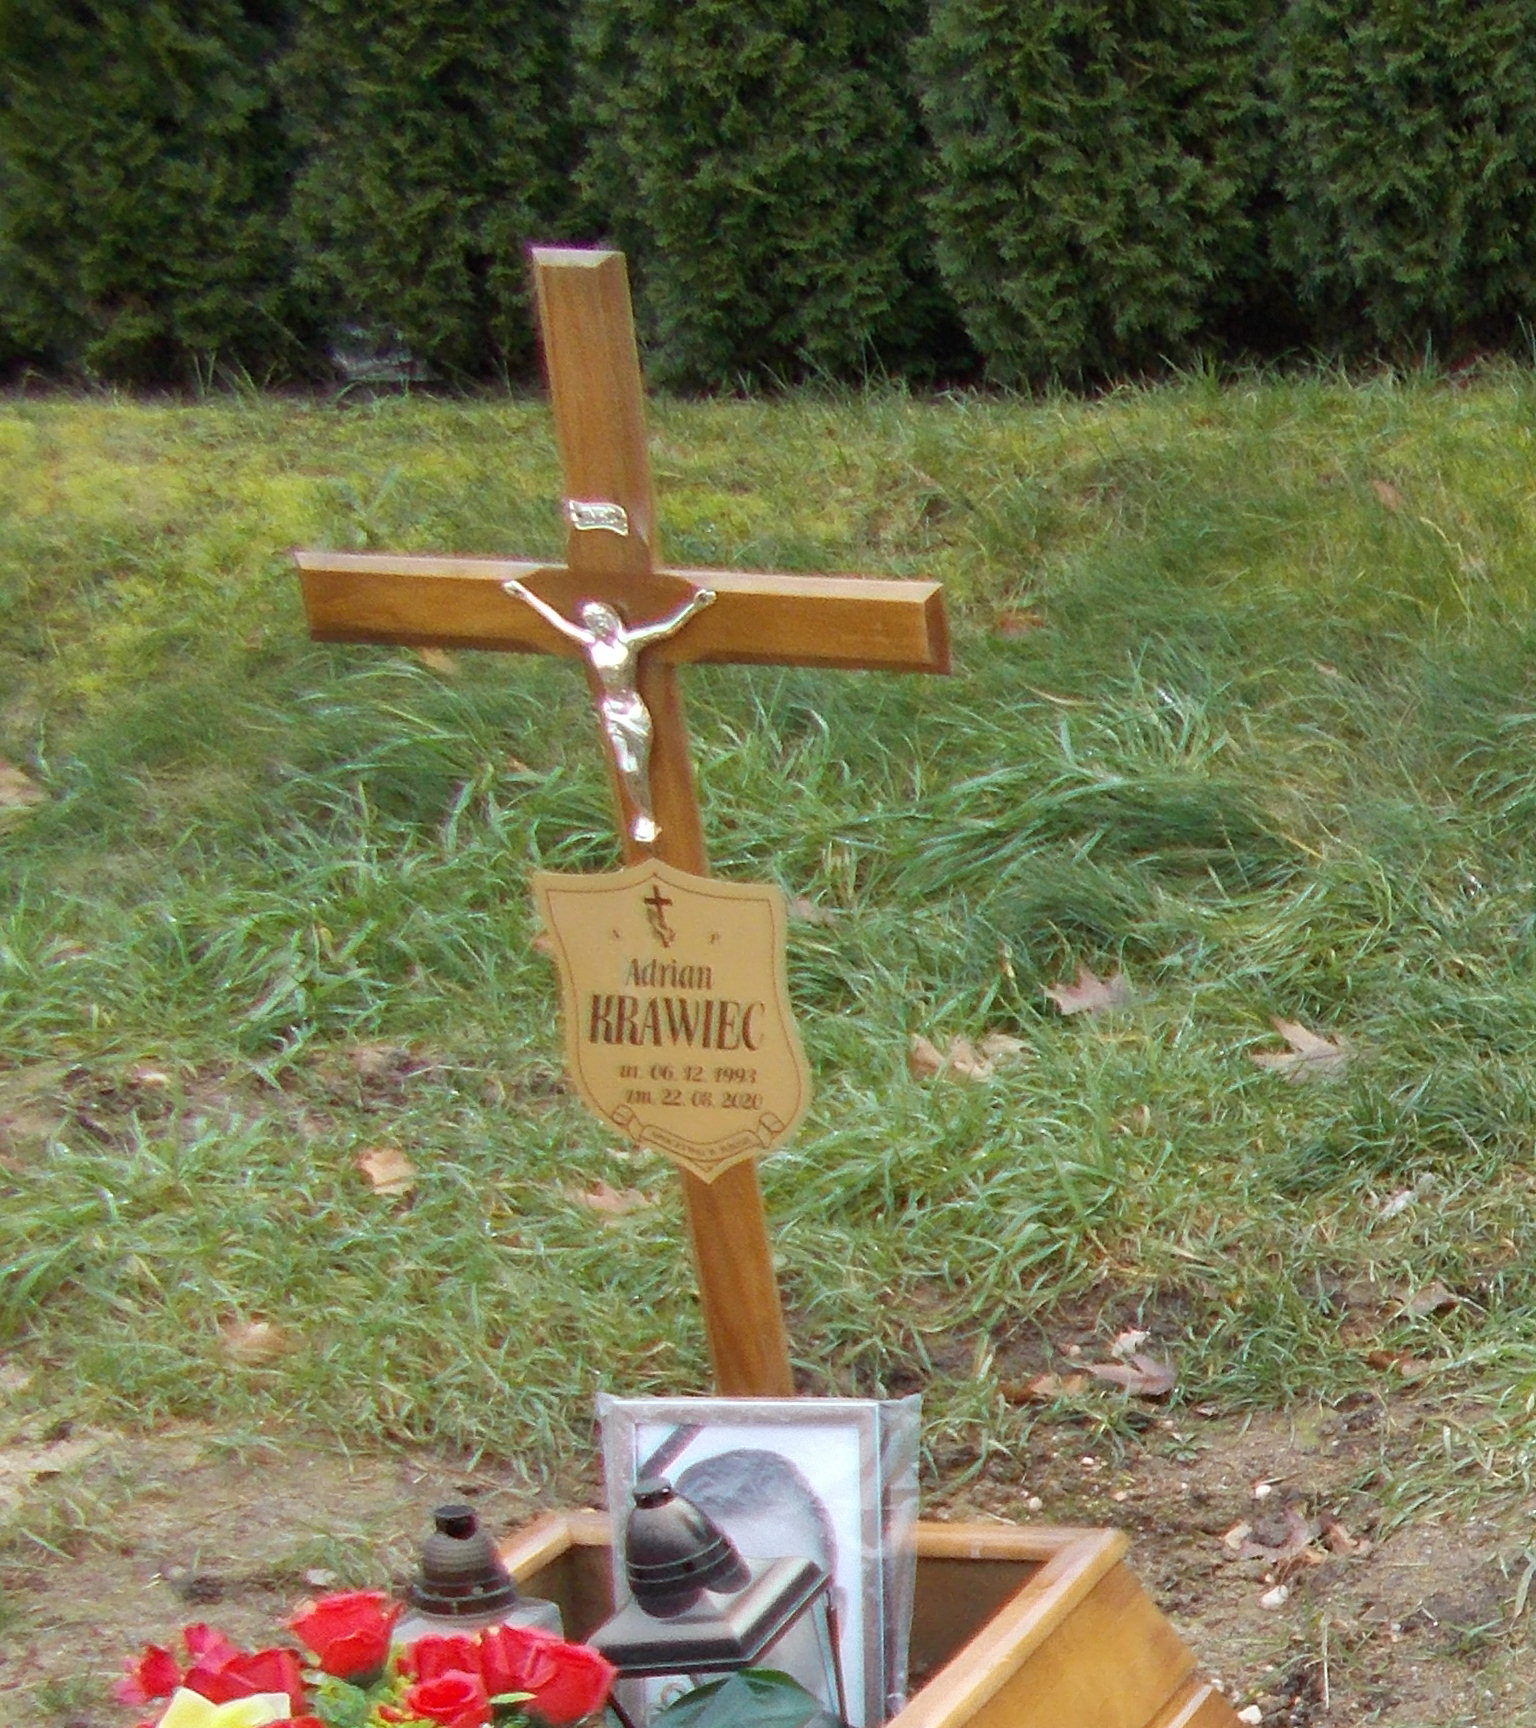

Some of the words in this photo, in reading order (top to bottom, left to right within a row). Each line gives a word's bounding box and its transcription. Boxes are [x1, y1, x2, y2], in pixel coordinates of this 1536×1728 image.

[625, 958, 715, 991] Adrian
[588, 993, 766, 1051] KRAWIEC
[721, 1092, 764, 1111] 2020
